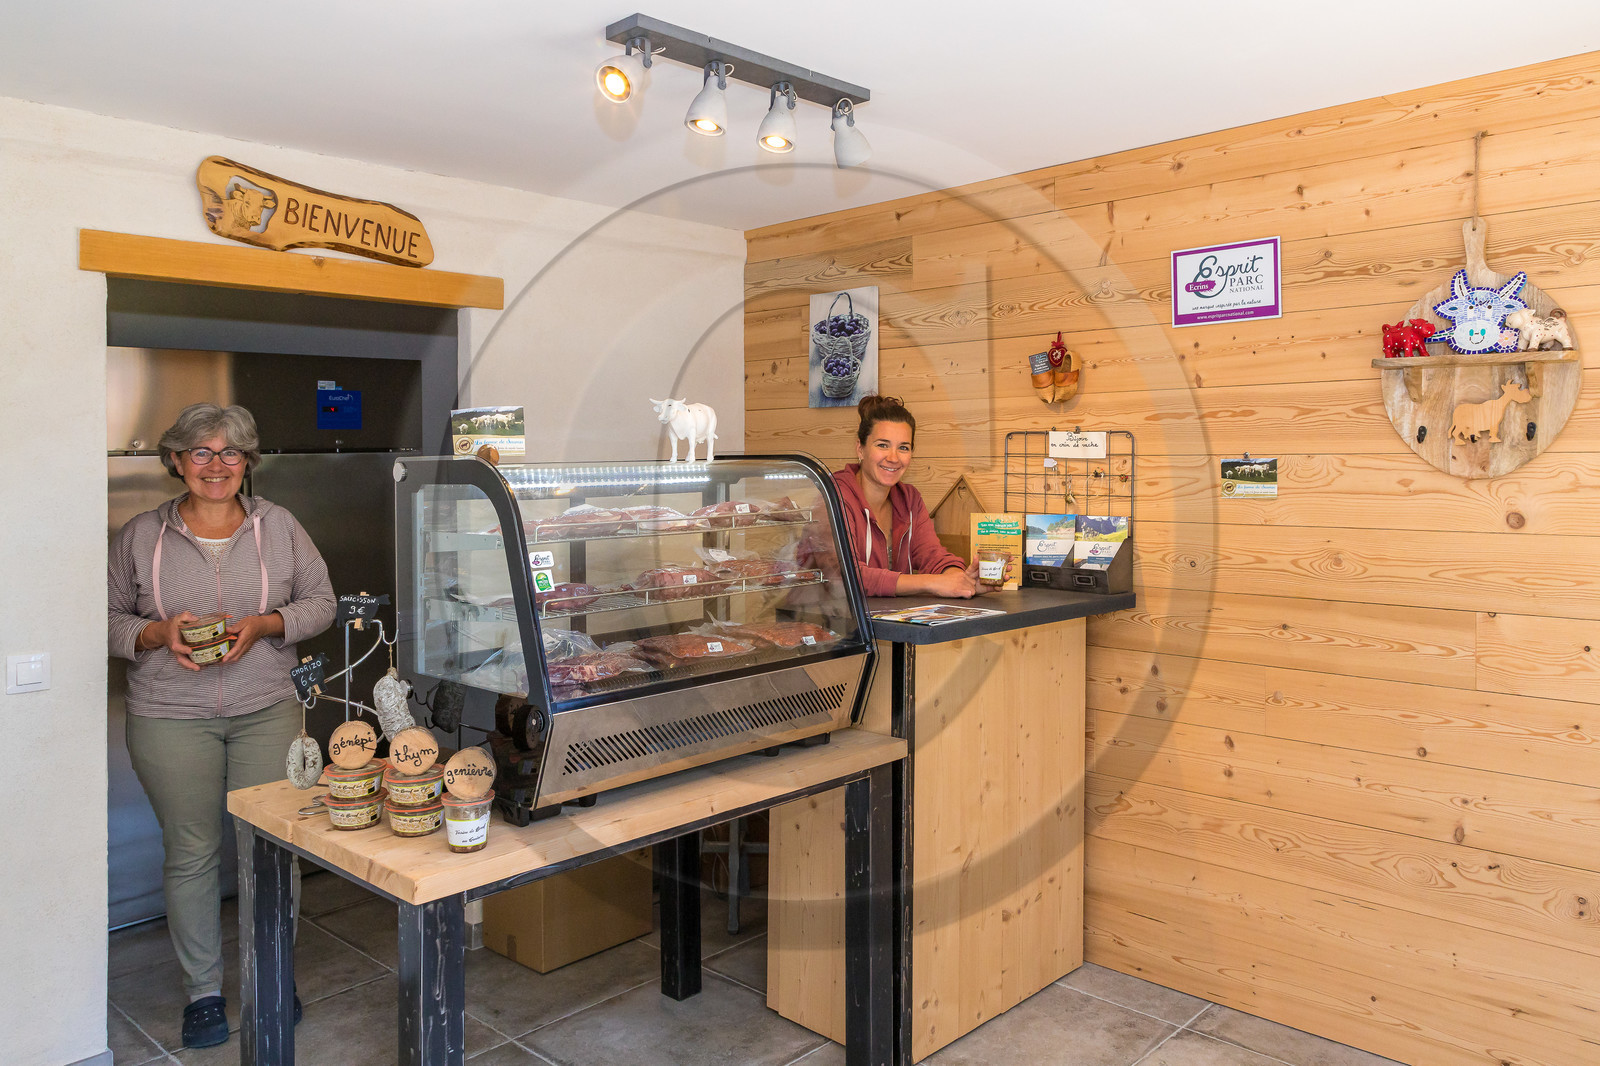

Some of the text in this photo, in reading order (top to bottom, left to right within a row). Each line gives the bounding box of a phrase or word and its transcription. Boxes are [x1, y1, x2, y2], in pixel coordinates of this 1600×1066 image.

[284, 198, 420, 258] BIENVENUE
[1192, 255, 1263, 298] Esprit
[1230, 274, 1264, 287] PARC
[1190, 283, 1208, 291] Ecrins
[1230, 285, 1264, 293] NATIONAL
[1197, 310, 1254, 320] www.espritparcnational.com
[340, 596, 376, 604] SAUCISSON
[292, 660, 322, 677] CHORIZO
[333, 732, 373, 755] génépi
[394, 745, 437, 766] thym
[446, 764, 493, 784] genièvre
